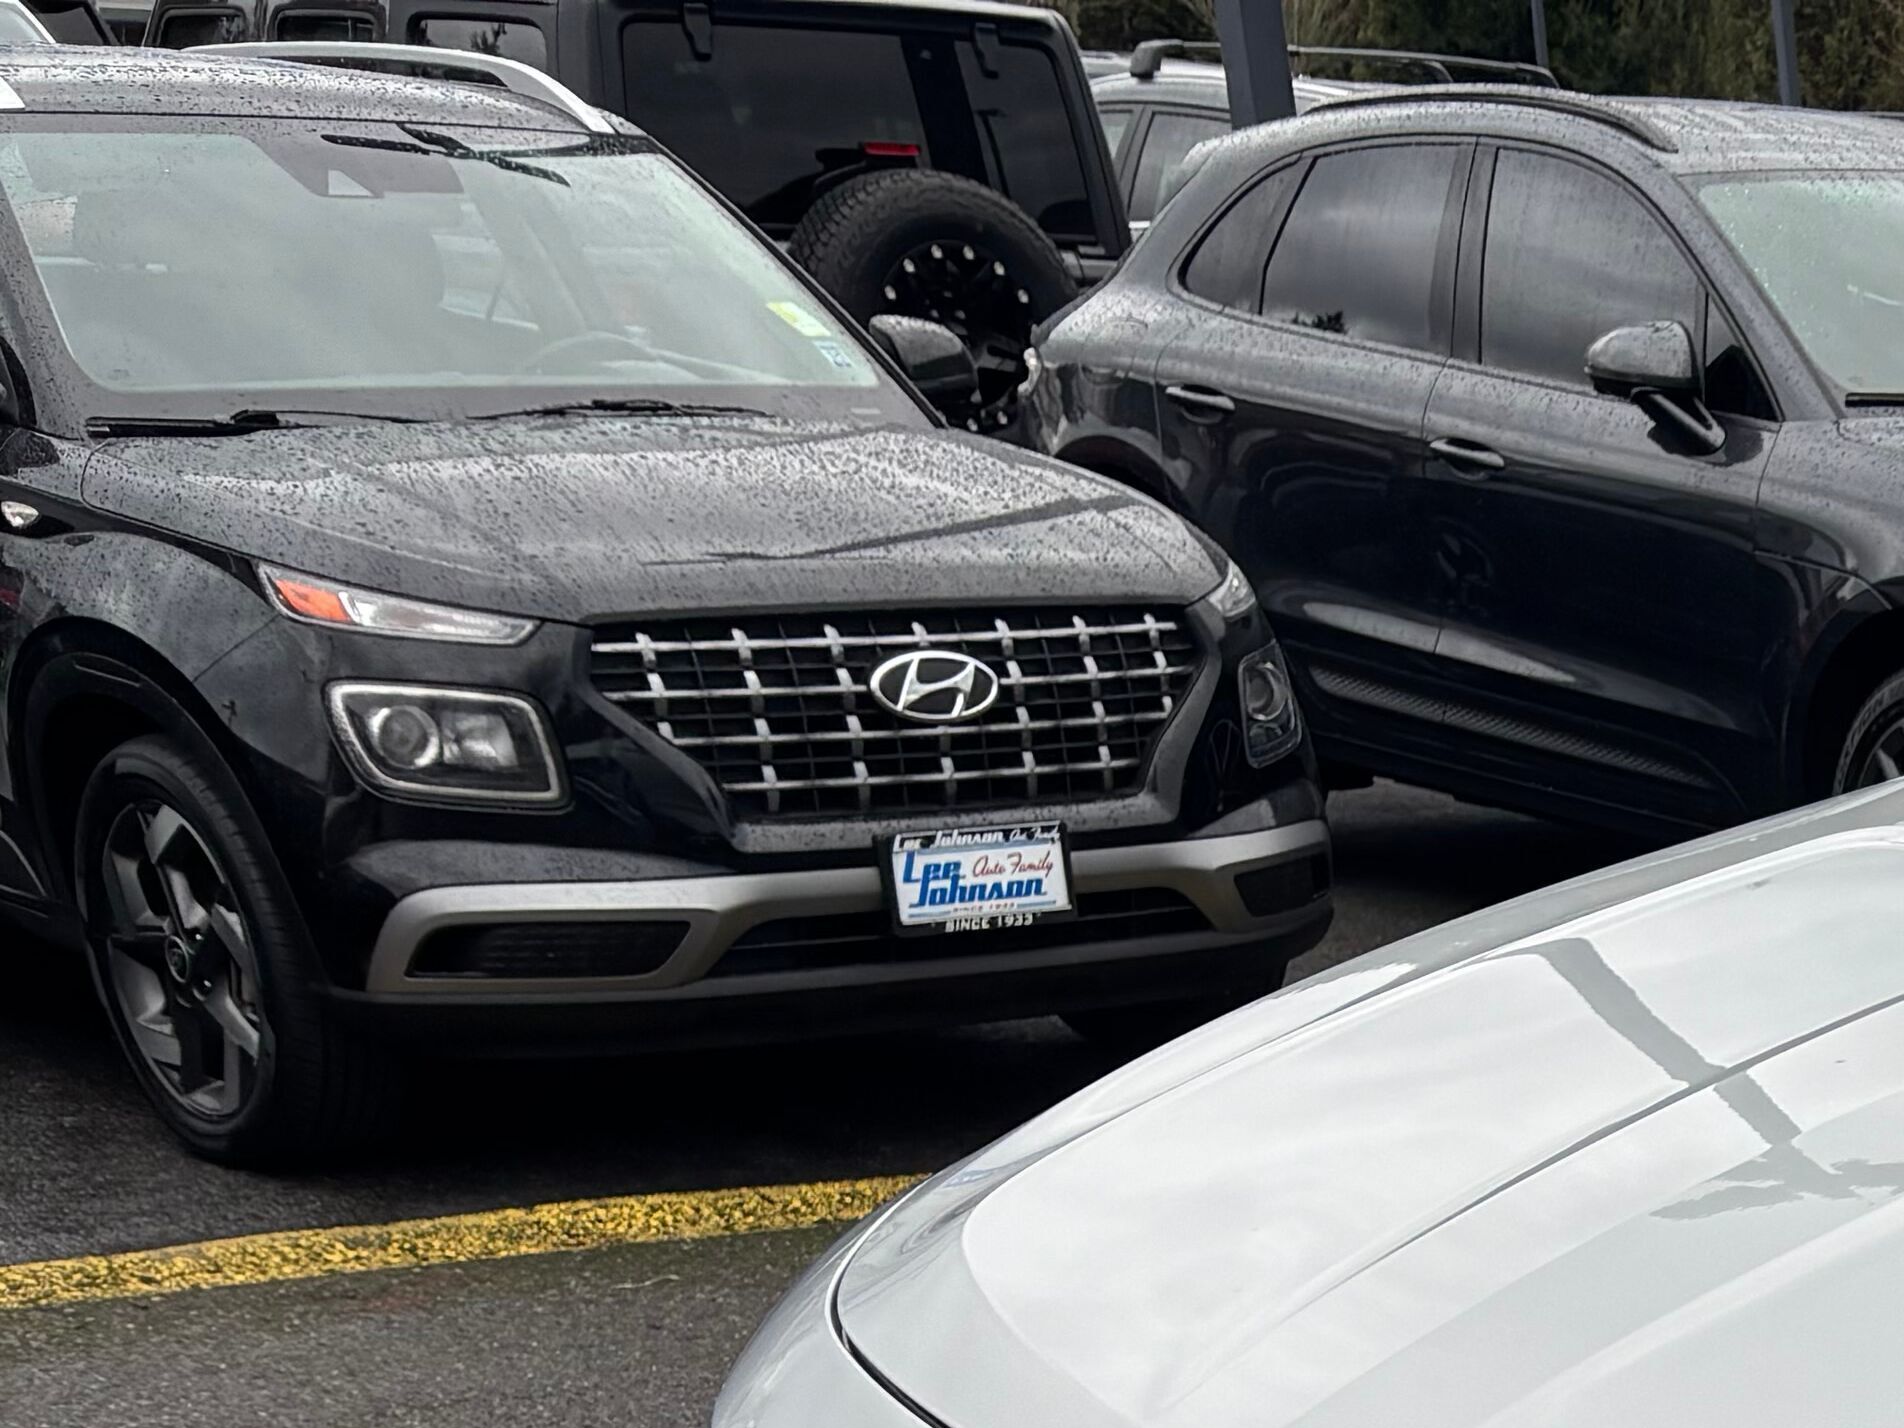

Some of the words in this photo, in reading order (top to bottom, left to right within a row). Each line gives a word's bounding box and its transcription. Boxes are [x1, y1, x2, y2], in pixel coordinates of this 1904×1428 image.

[930, 828, 1005, 849] Johnson
[903, 852, 967, 883] Lee
[972, 854, 1005, 878] Auto
[1008, 851, 1053, 878] Family
[908, 873, 1048, 908] Johnson
[945, 918, 990, 932] SINCE
[997, 914, 1034, 928] 1933
